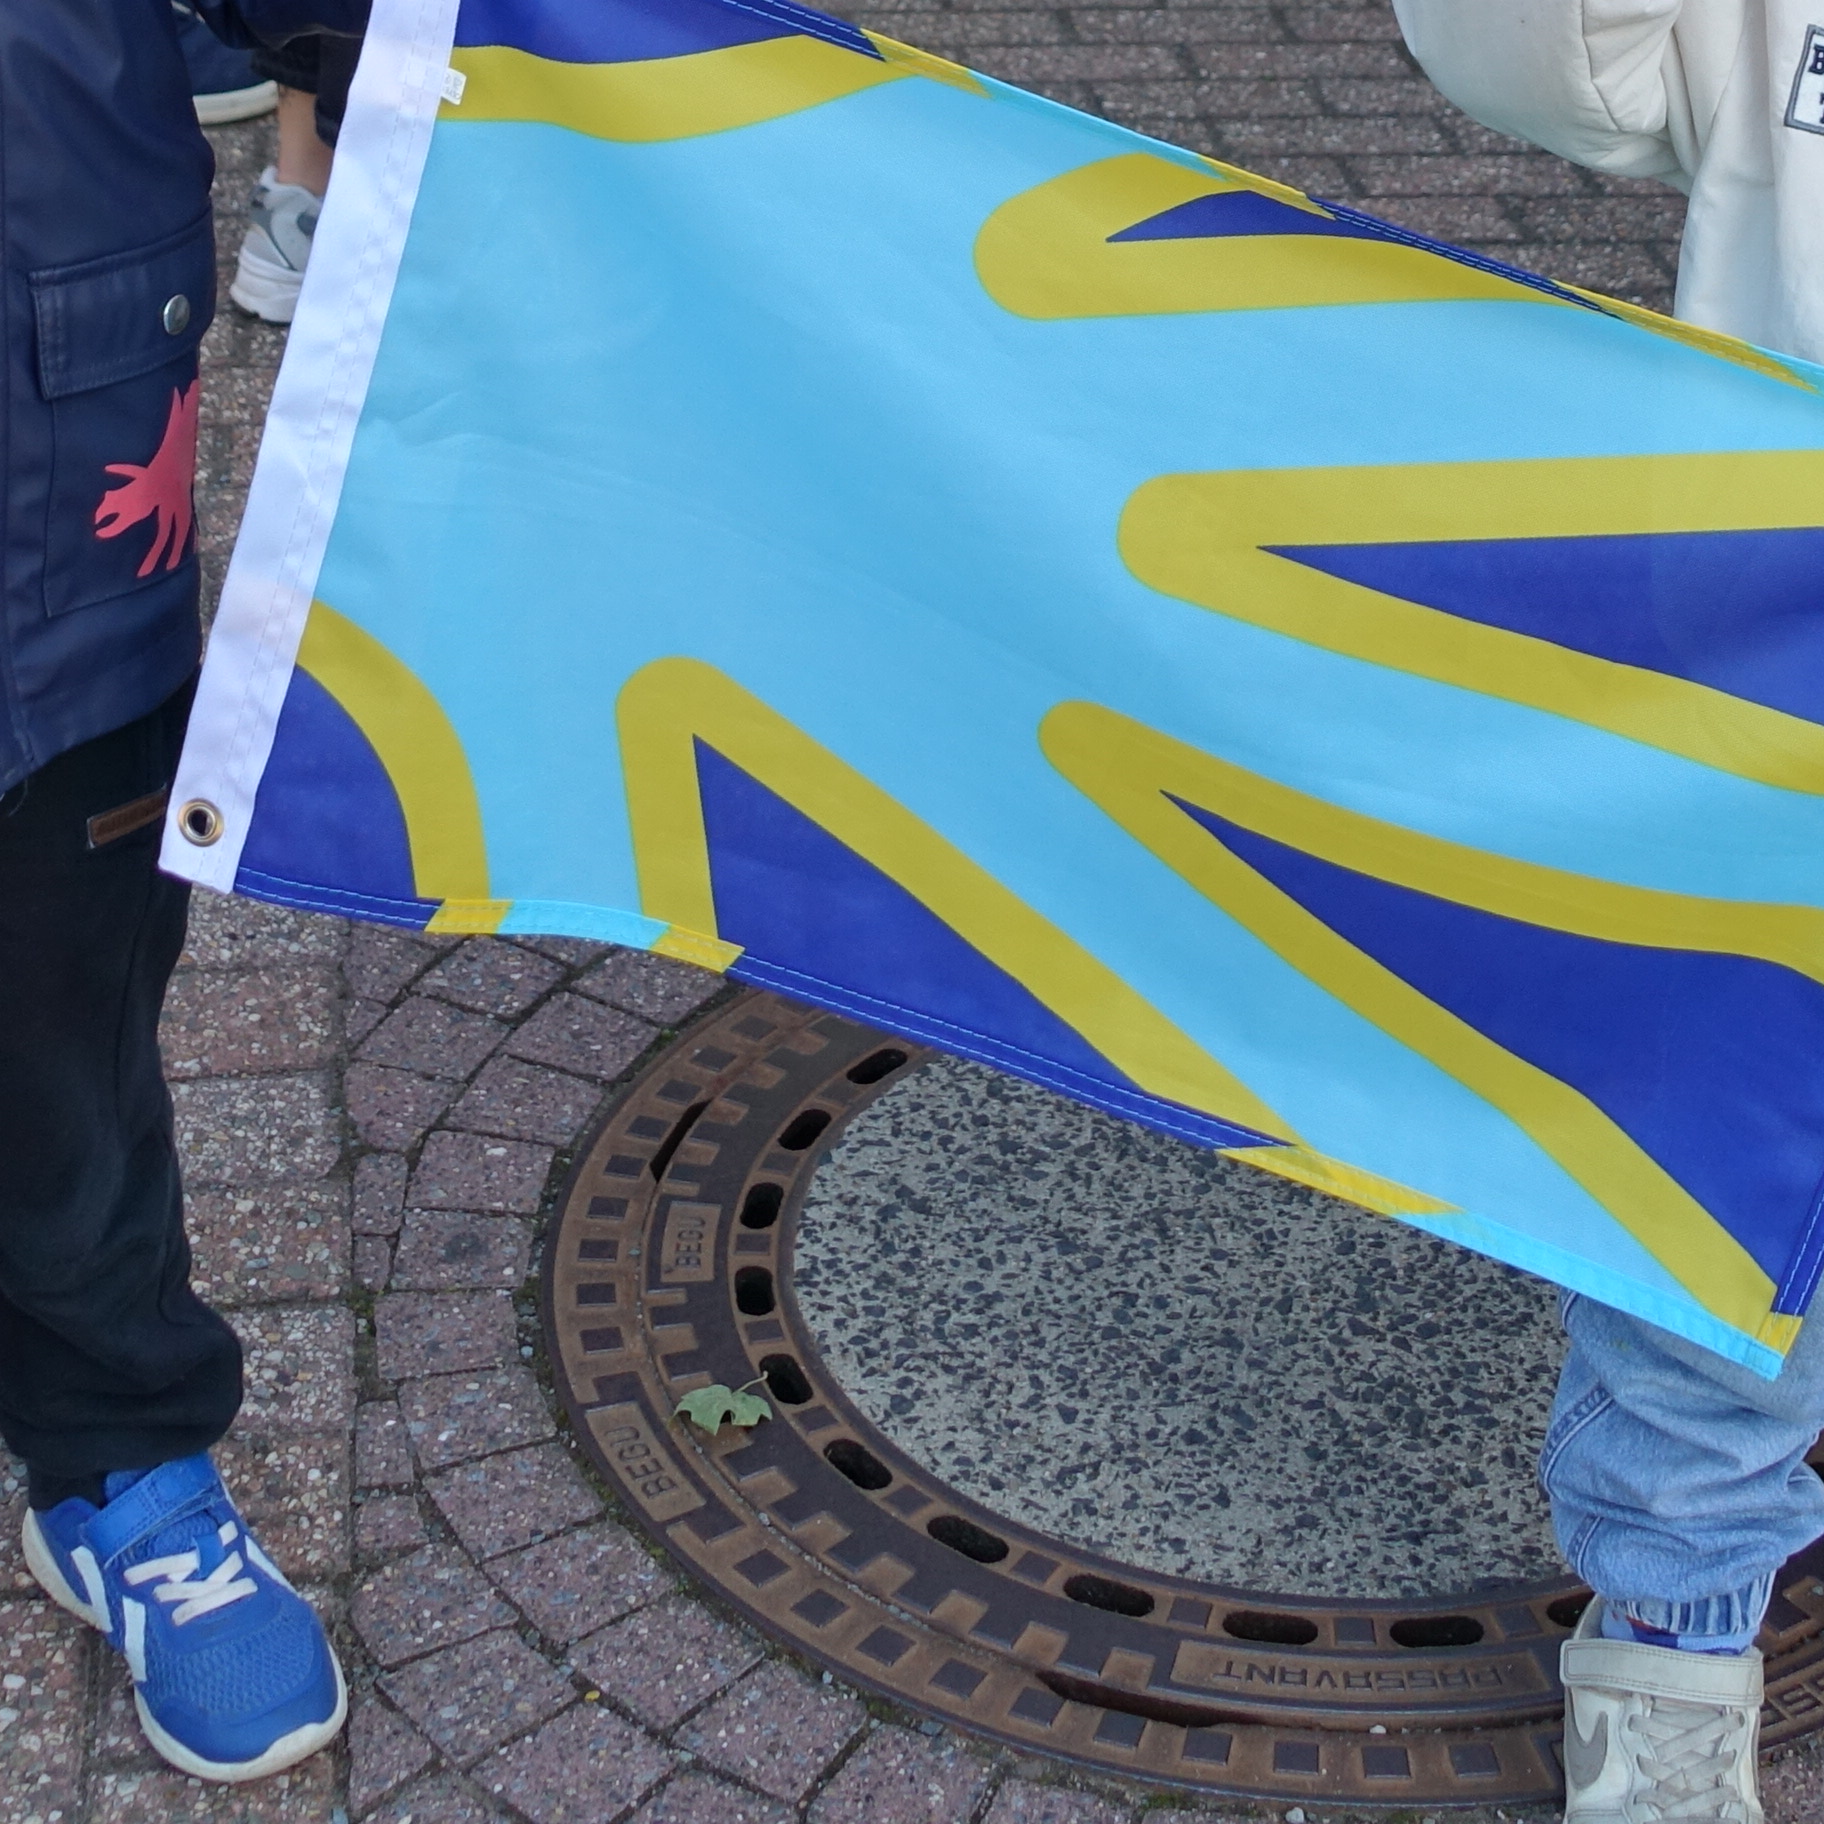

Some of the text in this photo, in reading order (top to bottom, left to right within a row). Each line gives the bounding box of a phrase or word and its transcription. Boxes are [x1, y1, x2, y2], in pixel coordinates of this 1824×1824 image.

[674, 1216, 706, 1269] BEGU
[603, 1425, 678, 1499] BEGU
[1212, 1660, 1503, 1692] PASSAVANT
